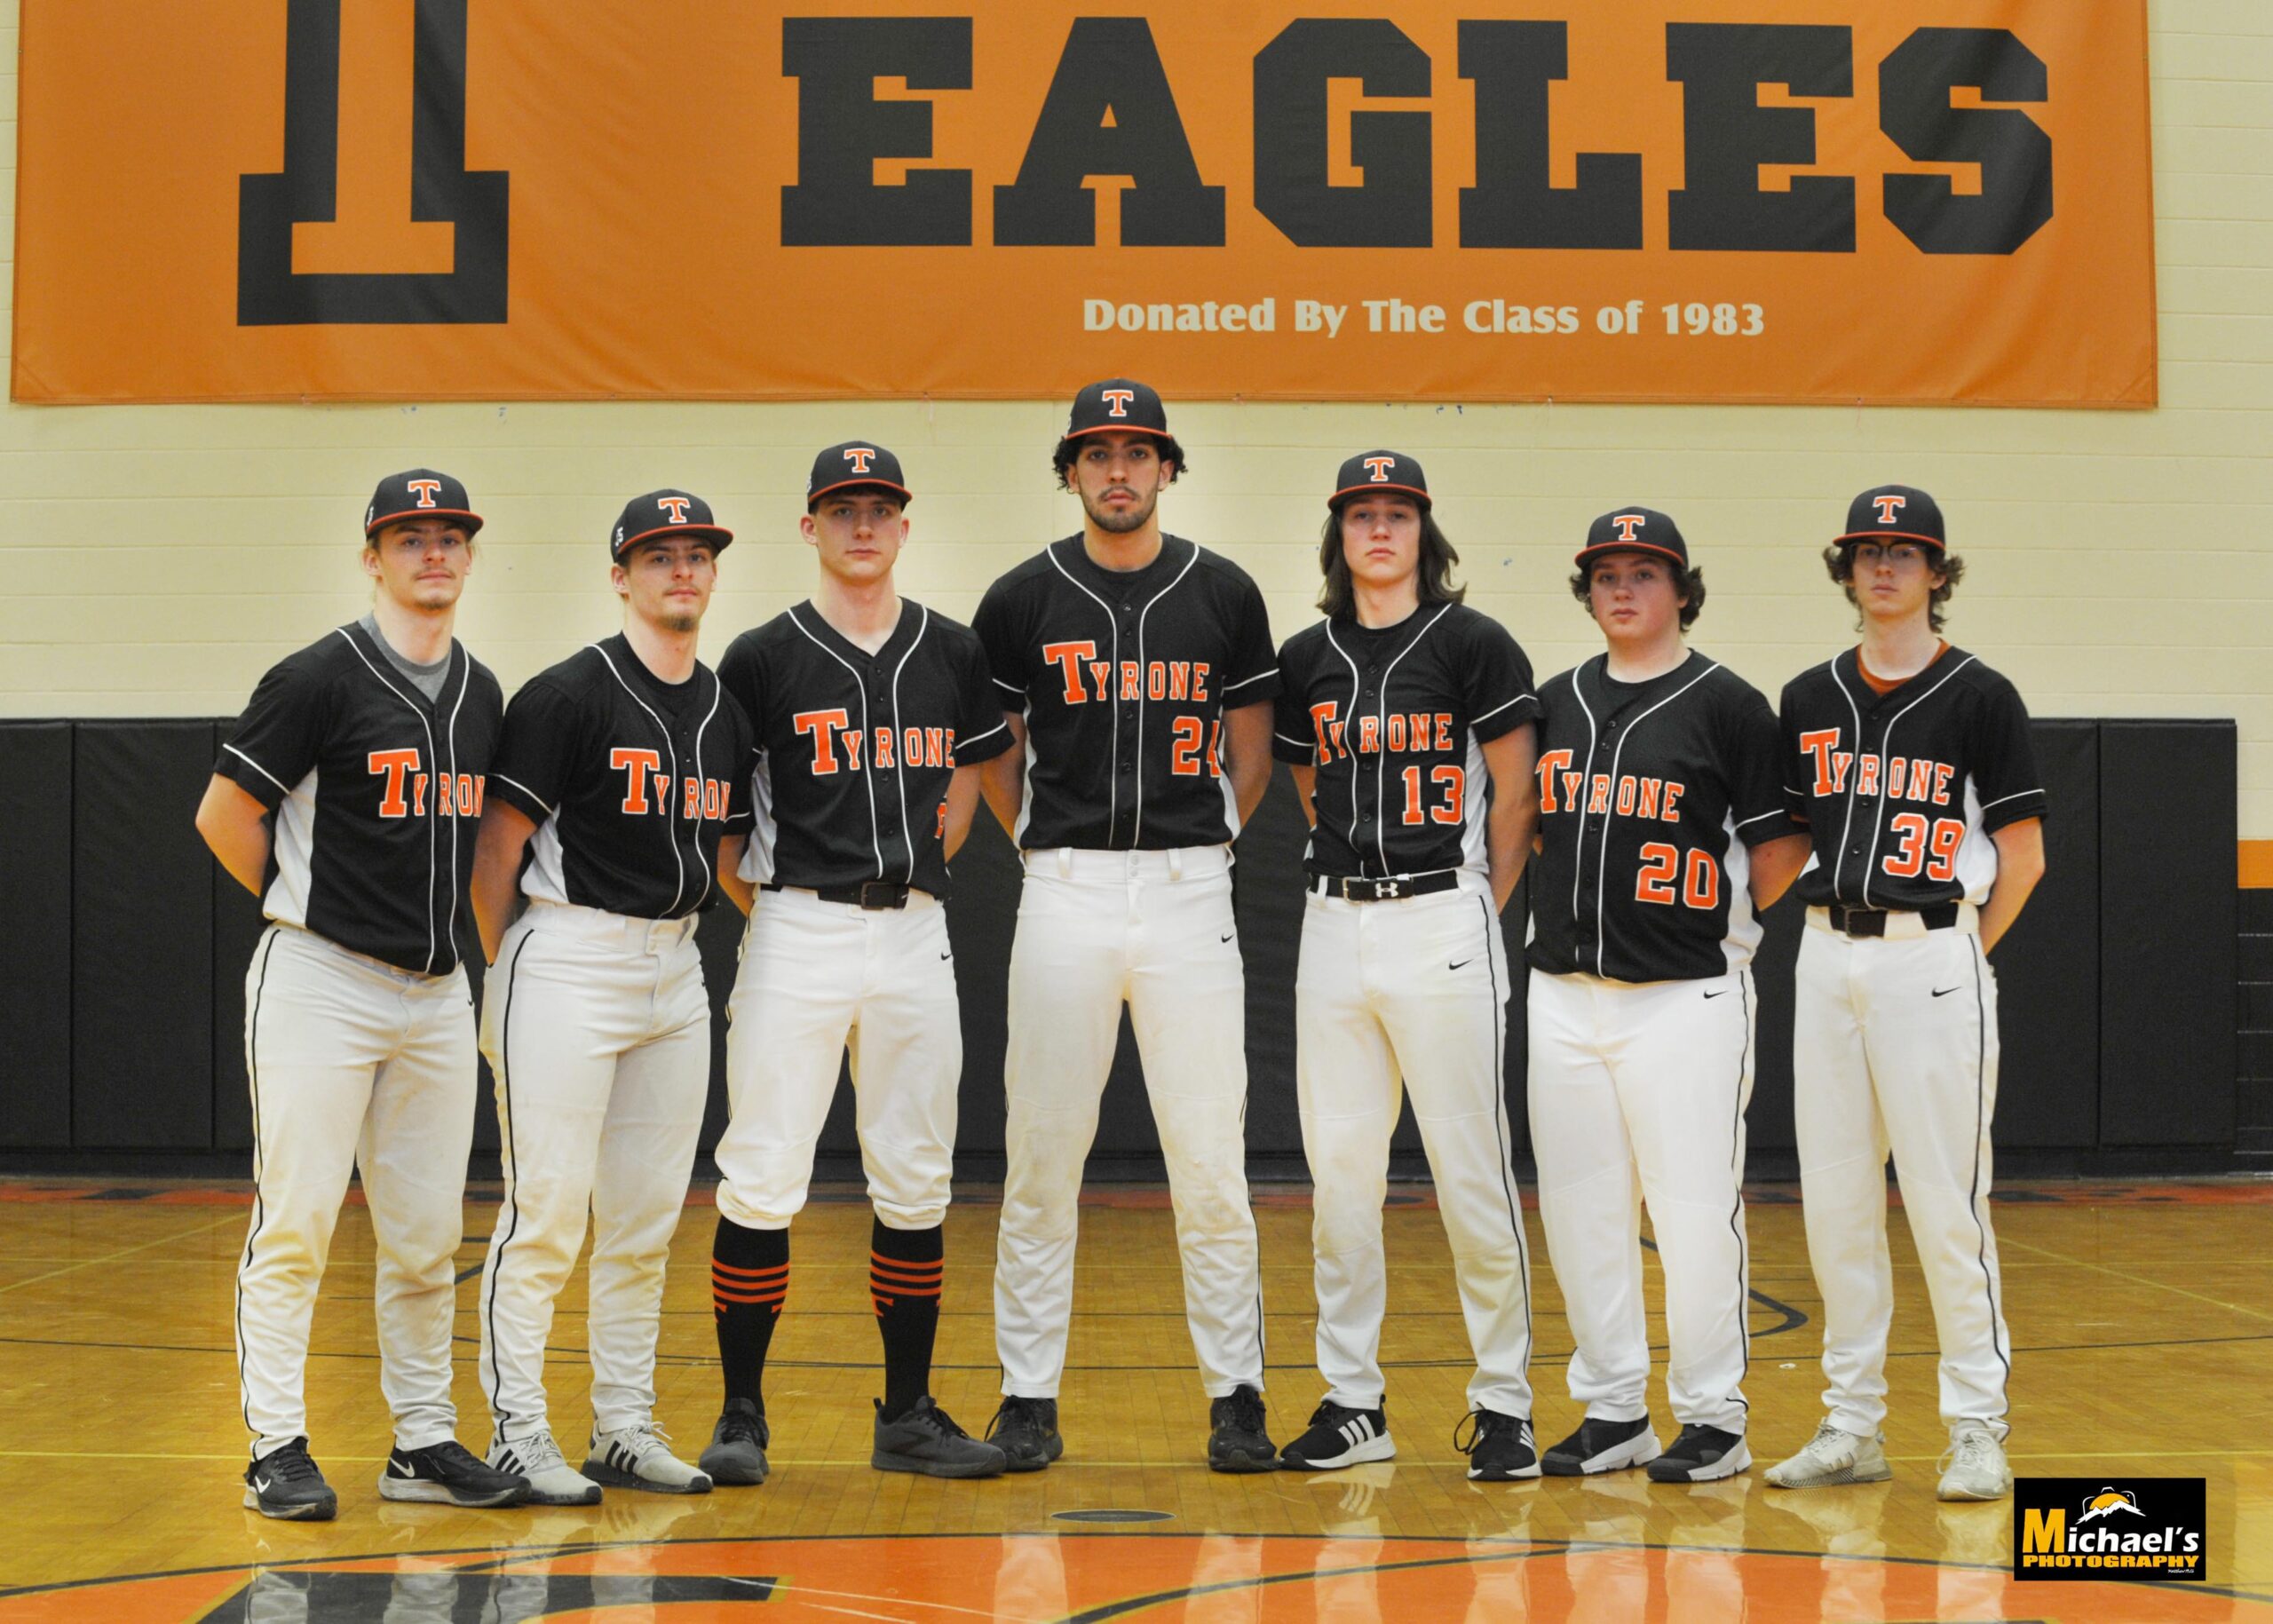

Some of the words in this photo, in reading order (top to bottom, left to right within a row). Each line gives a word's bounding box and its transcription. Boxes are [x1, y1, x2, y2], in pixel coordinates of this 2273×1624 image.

[780, 16, 2054, 255] EAGLES
[1083, 297, 1276, 332] Donated
[1295, 299, 1348, 338] By
[1361, 298, 1446, 333] The
[1463, 298, 1579, 334] Class
[1596, 299, 1644, 335] of
[1661, 302, 1765, 336] 1983
[1102, 389, 1134, 417] T
[843, 448, 875, 473] T
[1363, 456, 1395, 482] T
[408, 479, 442, 508] T
[657, 496, 691, 524] T
[1872, 495, 1906, 524] T
[1612, 514, 1645, 541] T
[368, 748, 486, 818] TYRON
[609, 747, 731, 822] TYRON
[1401, 764, 1466, 827] 13
[1881, 812, 1967, 883] 39
[1635, 841, 1720, 911] 20
